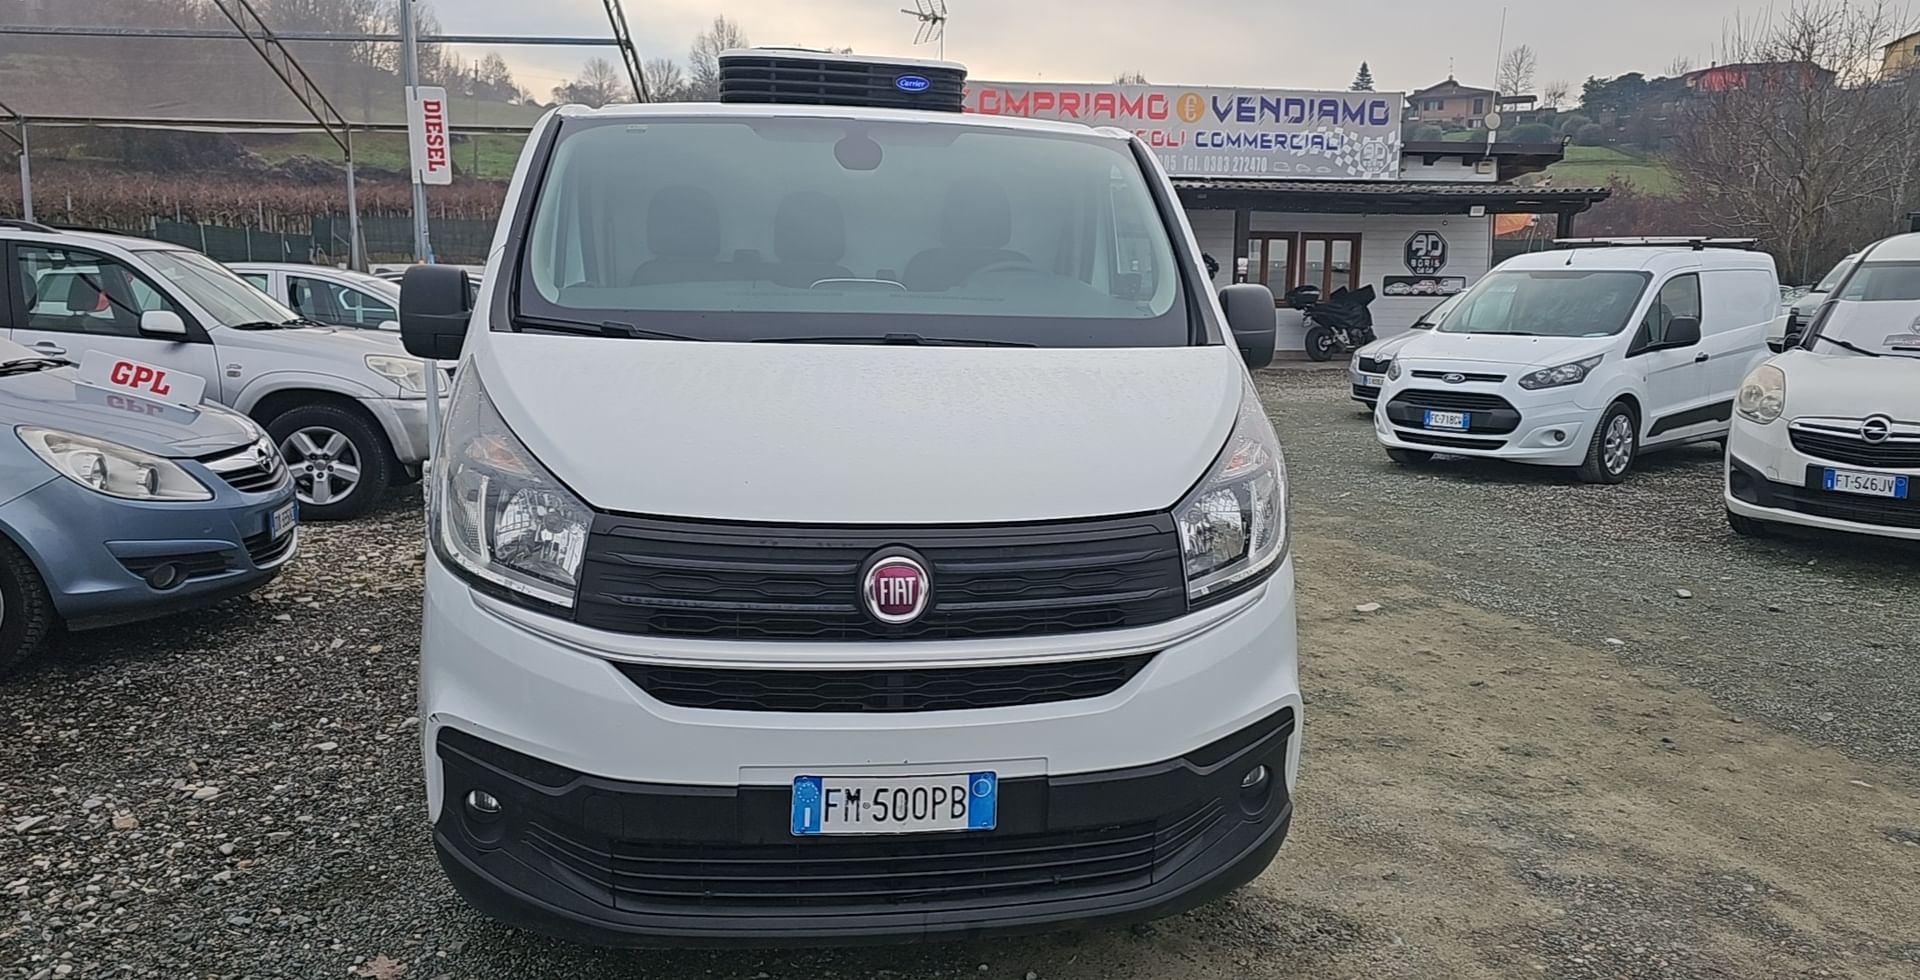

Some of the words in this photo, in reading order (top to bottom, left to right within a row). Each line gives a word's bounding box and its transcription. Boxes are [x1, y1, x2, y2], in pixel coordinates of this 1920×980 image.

[899, 80, 926, 88] Carrier
[1211, 95, 1390, 126] VENDIAMO
[423, 100, 446, 172] DIESEL
[1195, 131, 1344, 150] COMMERCIALI
[110, 361, 170, 396] GPL
[879, 576, 917, 606] FIAT
